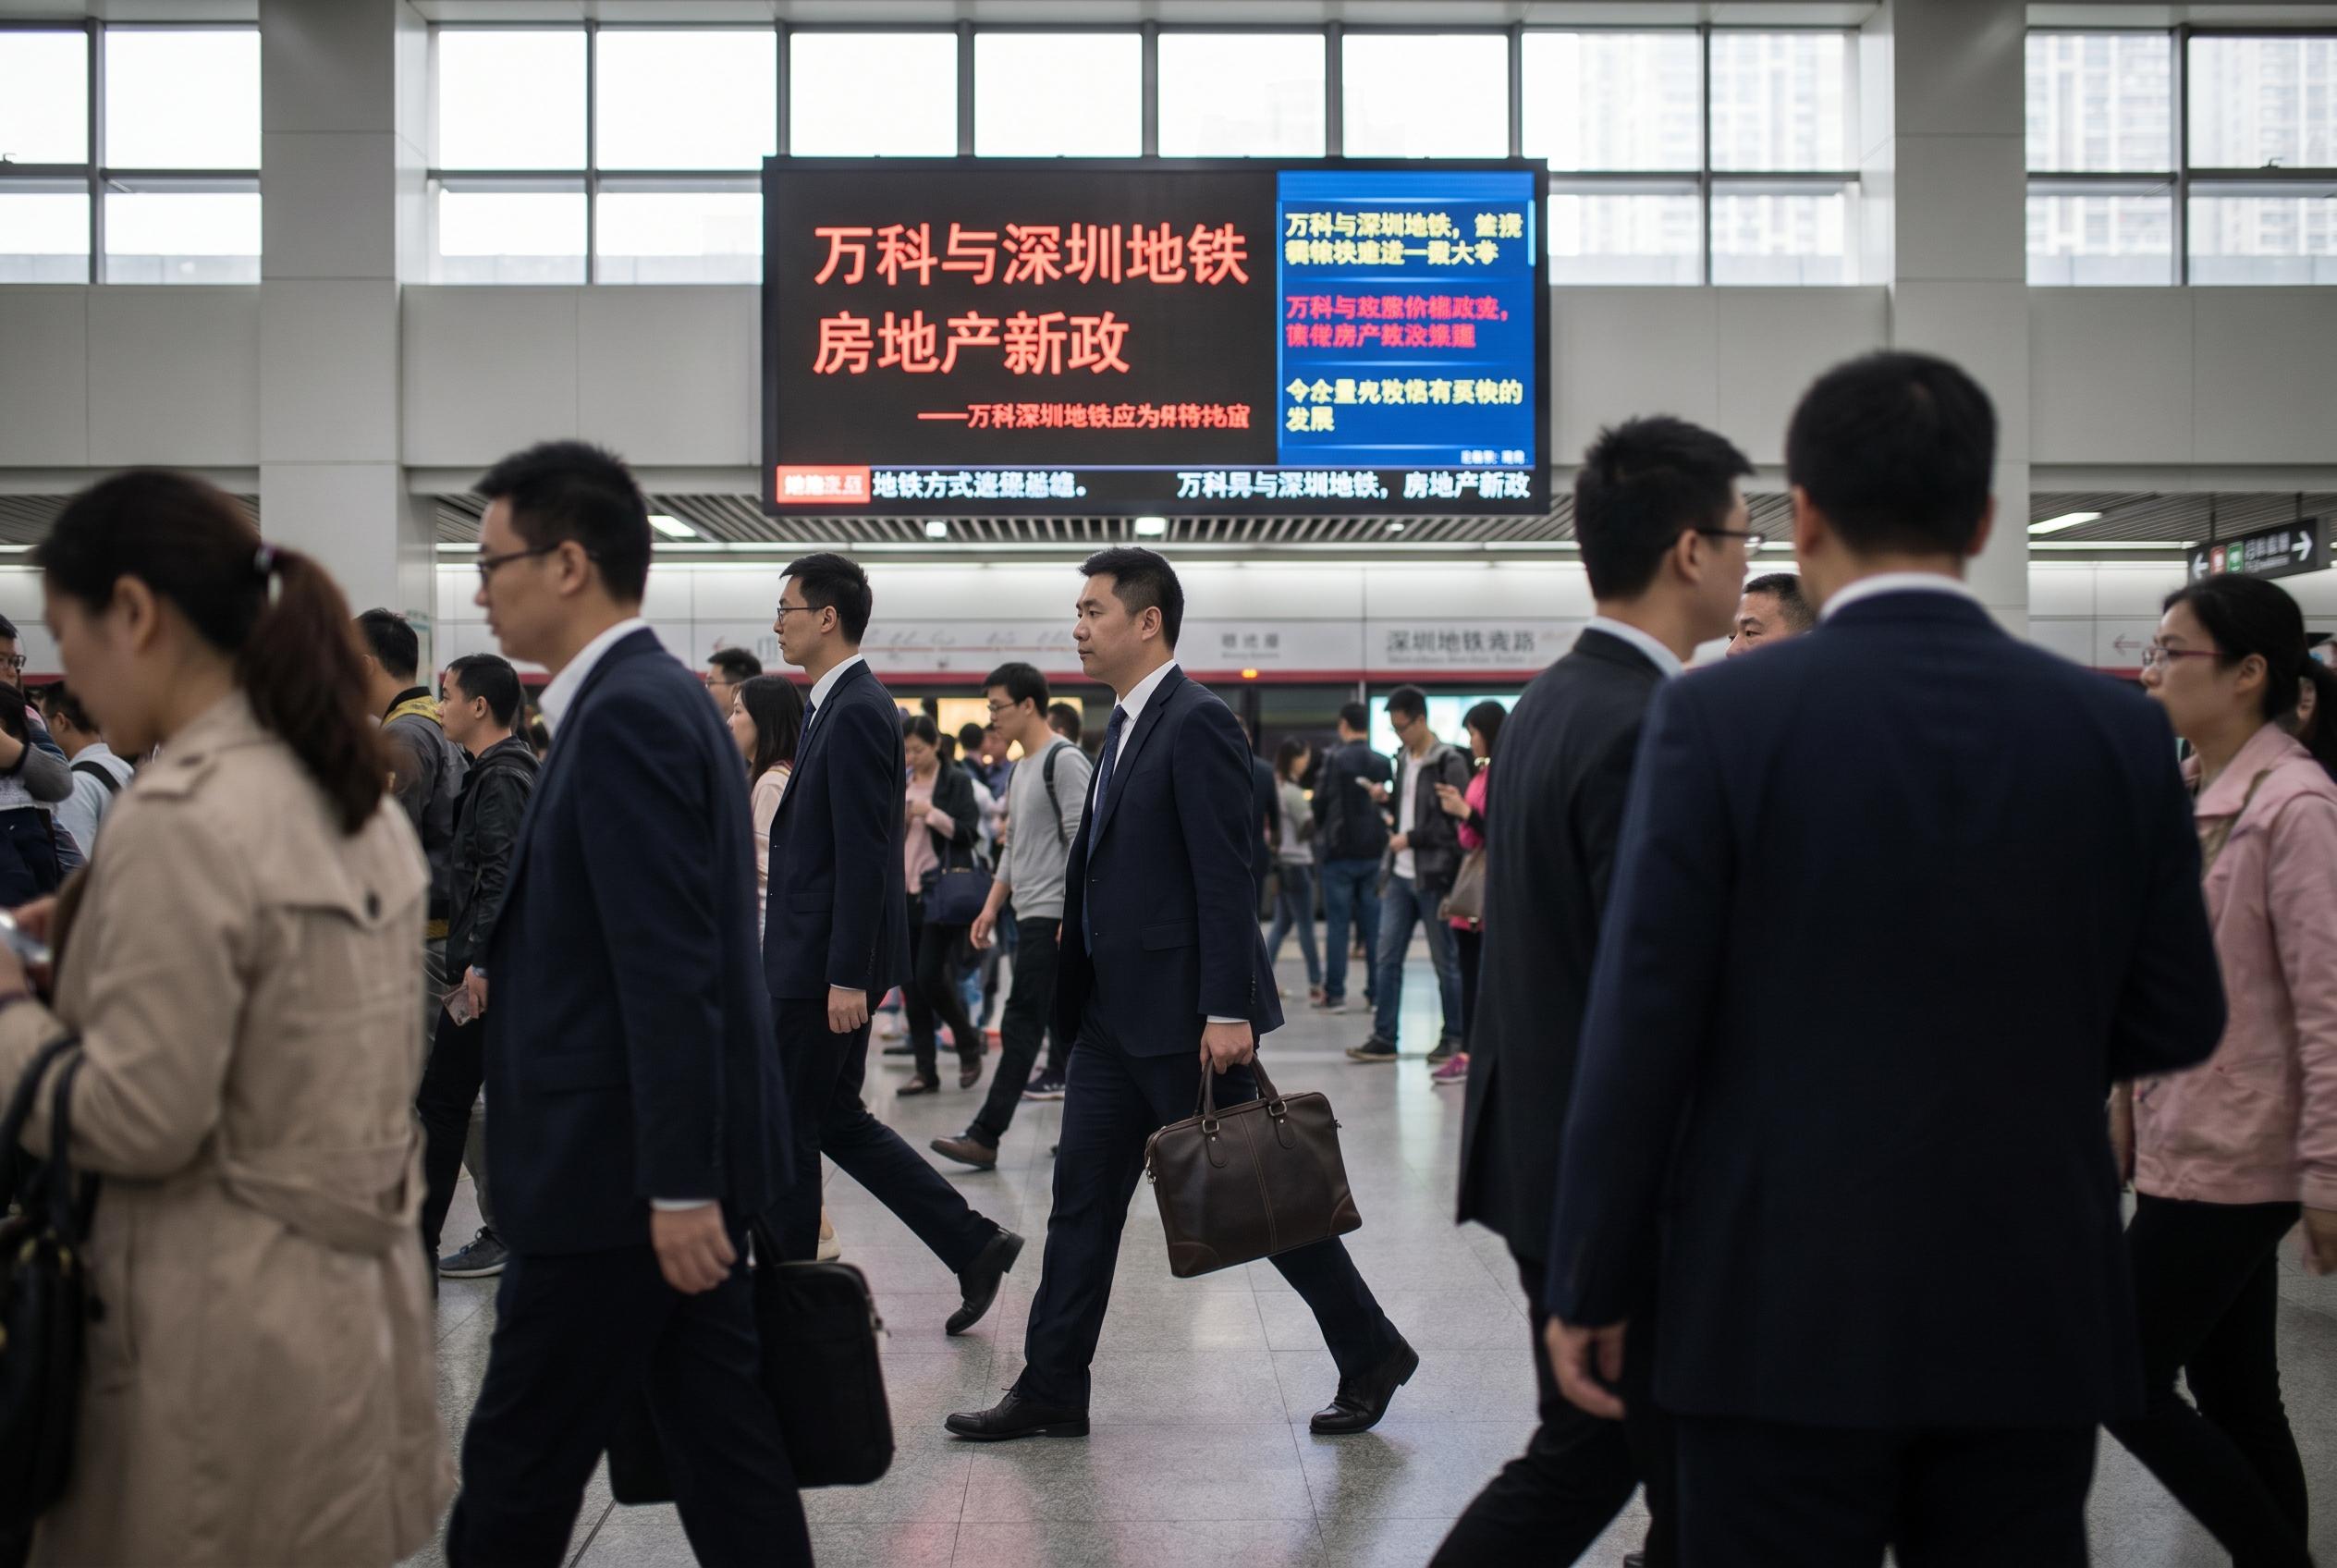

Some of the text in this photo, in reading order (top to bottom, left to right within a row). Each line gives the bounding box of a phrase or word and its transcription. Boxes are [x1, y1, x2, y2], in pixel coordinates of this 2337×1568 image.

[814, 222, 1250, 286] 万科与深圳地铁
[813, 311, 1131, 375] 房地产新政
